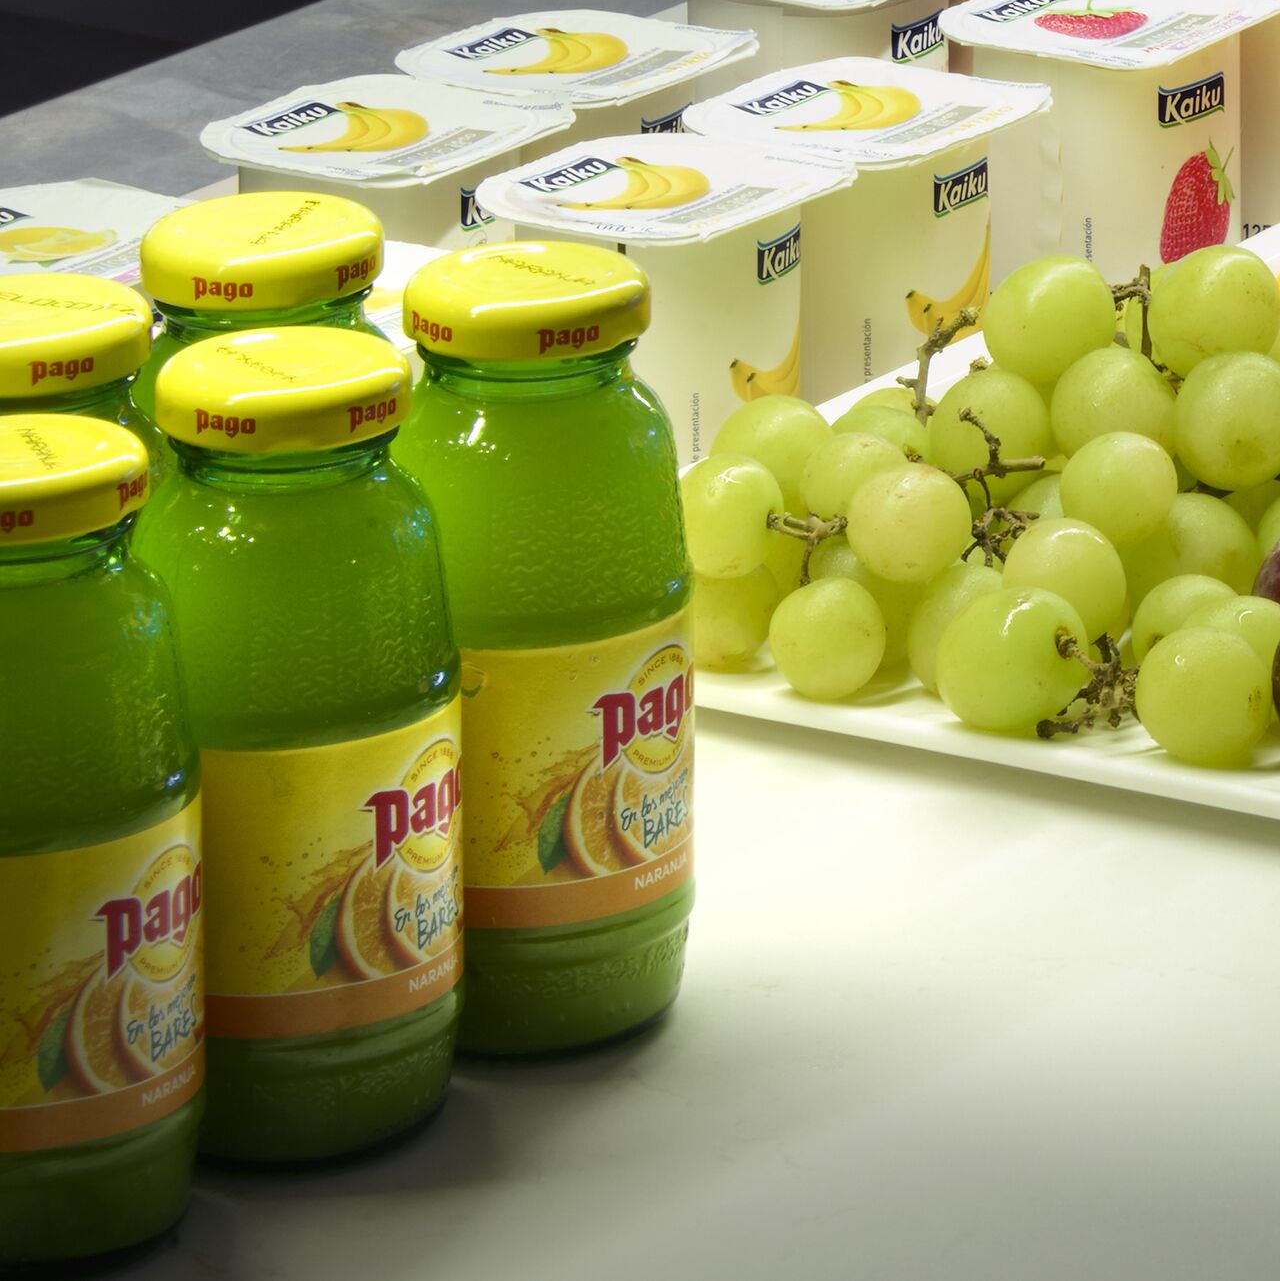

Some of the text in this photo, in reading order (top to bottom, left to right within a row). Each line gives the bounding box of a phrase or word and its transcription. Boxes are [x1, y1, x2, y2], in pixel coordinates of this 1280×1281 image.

[456, 29, 528, 60] Kaiku
[897, 21, 942, 59] Kaiku
[744, 83, 819, 116] Kaiku
[1165, 85, 1222, 123] Kaiku
[252, 106, 330, 137] Kaiku
[529, 160, 609, 193] Kaiku
[938, 171, 987, 213] Kaiku
[192, 276, 254, 303] pago
[336, 253, 377, 292] pago
[412, 310, 453, 343] pago
[536, 325, 600, 355] pago
[27, 356, 95, 386] pago
[194, 407, 257, 438] pago
[347, 397, 397, 433] pago
[638, 656, 666, 687] SINCE
[411, 750, 438, 783] SINCE
[632, 748, 672, 766] PREMIUM
[620, 807, 637, 832] En
[641, 793, 658, 818] los
[643, 784, 689, 850] BARES
[406, 847, 444, 864] PREMIUM
[634, 851, 688, 891] NARANJA
[143, 857, 172, 891] SINCE
[394, 906, 411, 933] En
[415, 893, 431, 919] los
[417, 883, 460, 951] BARES
[126, 1019, 144, 1046] En
[148, 1004, 165, 1031] los
[151, 993, 199, 1064] BARES
[141, 1064, 196, 1108] NARANJA
